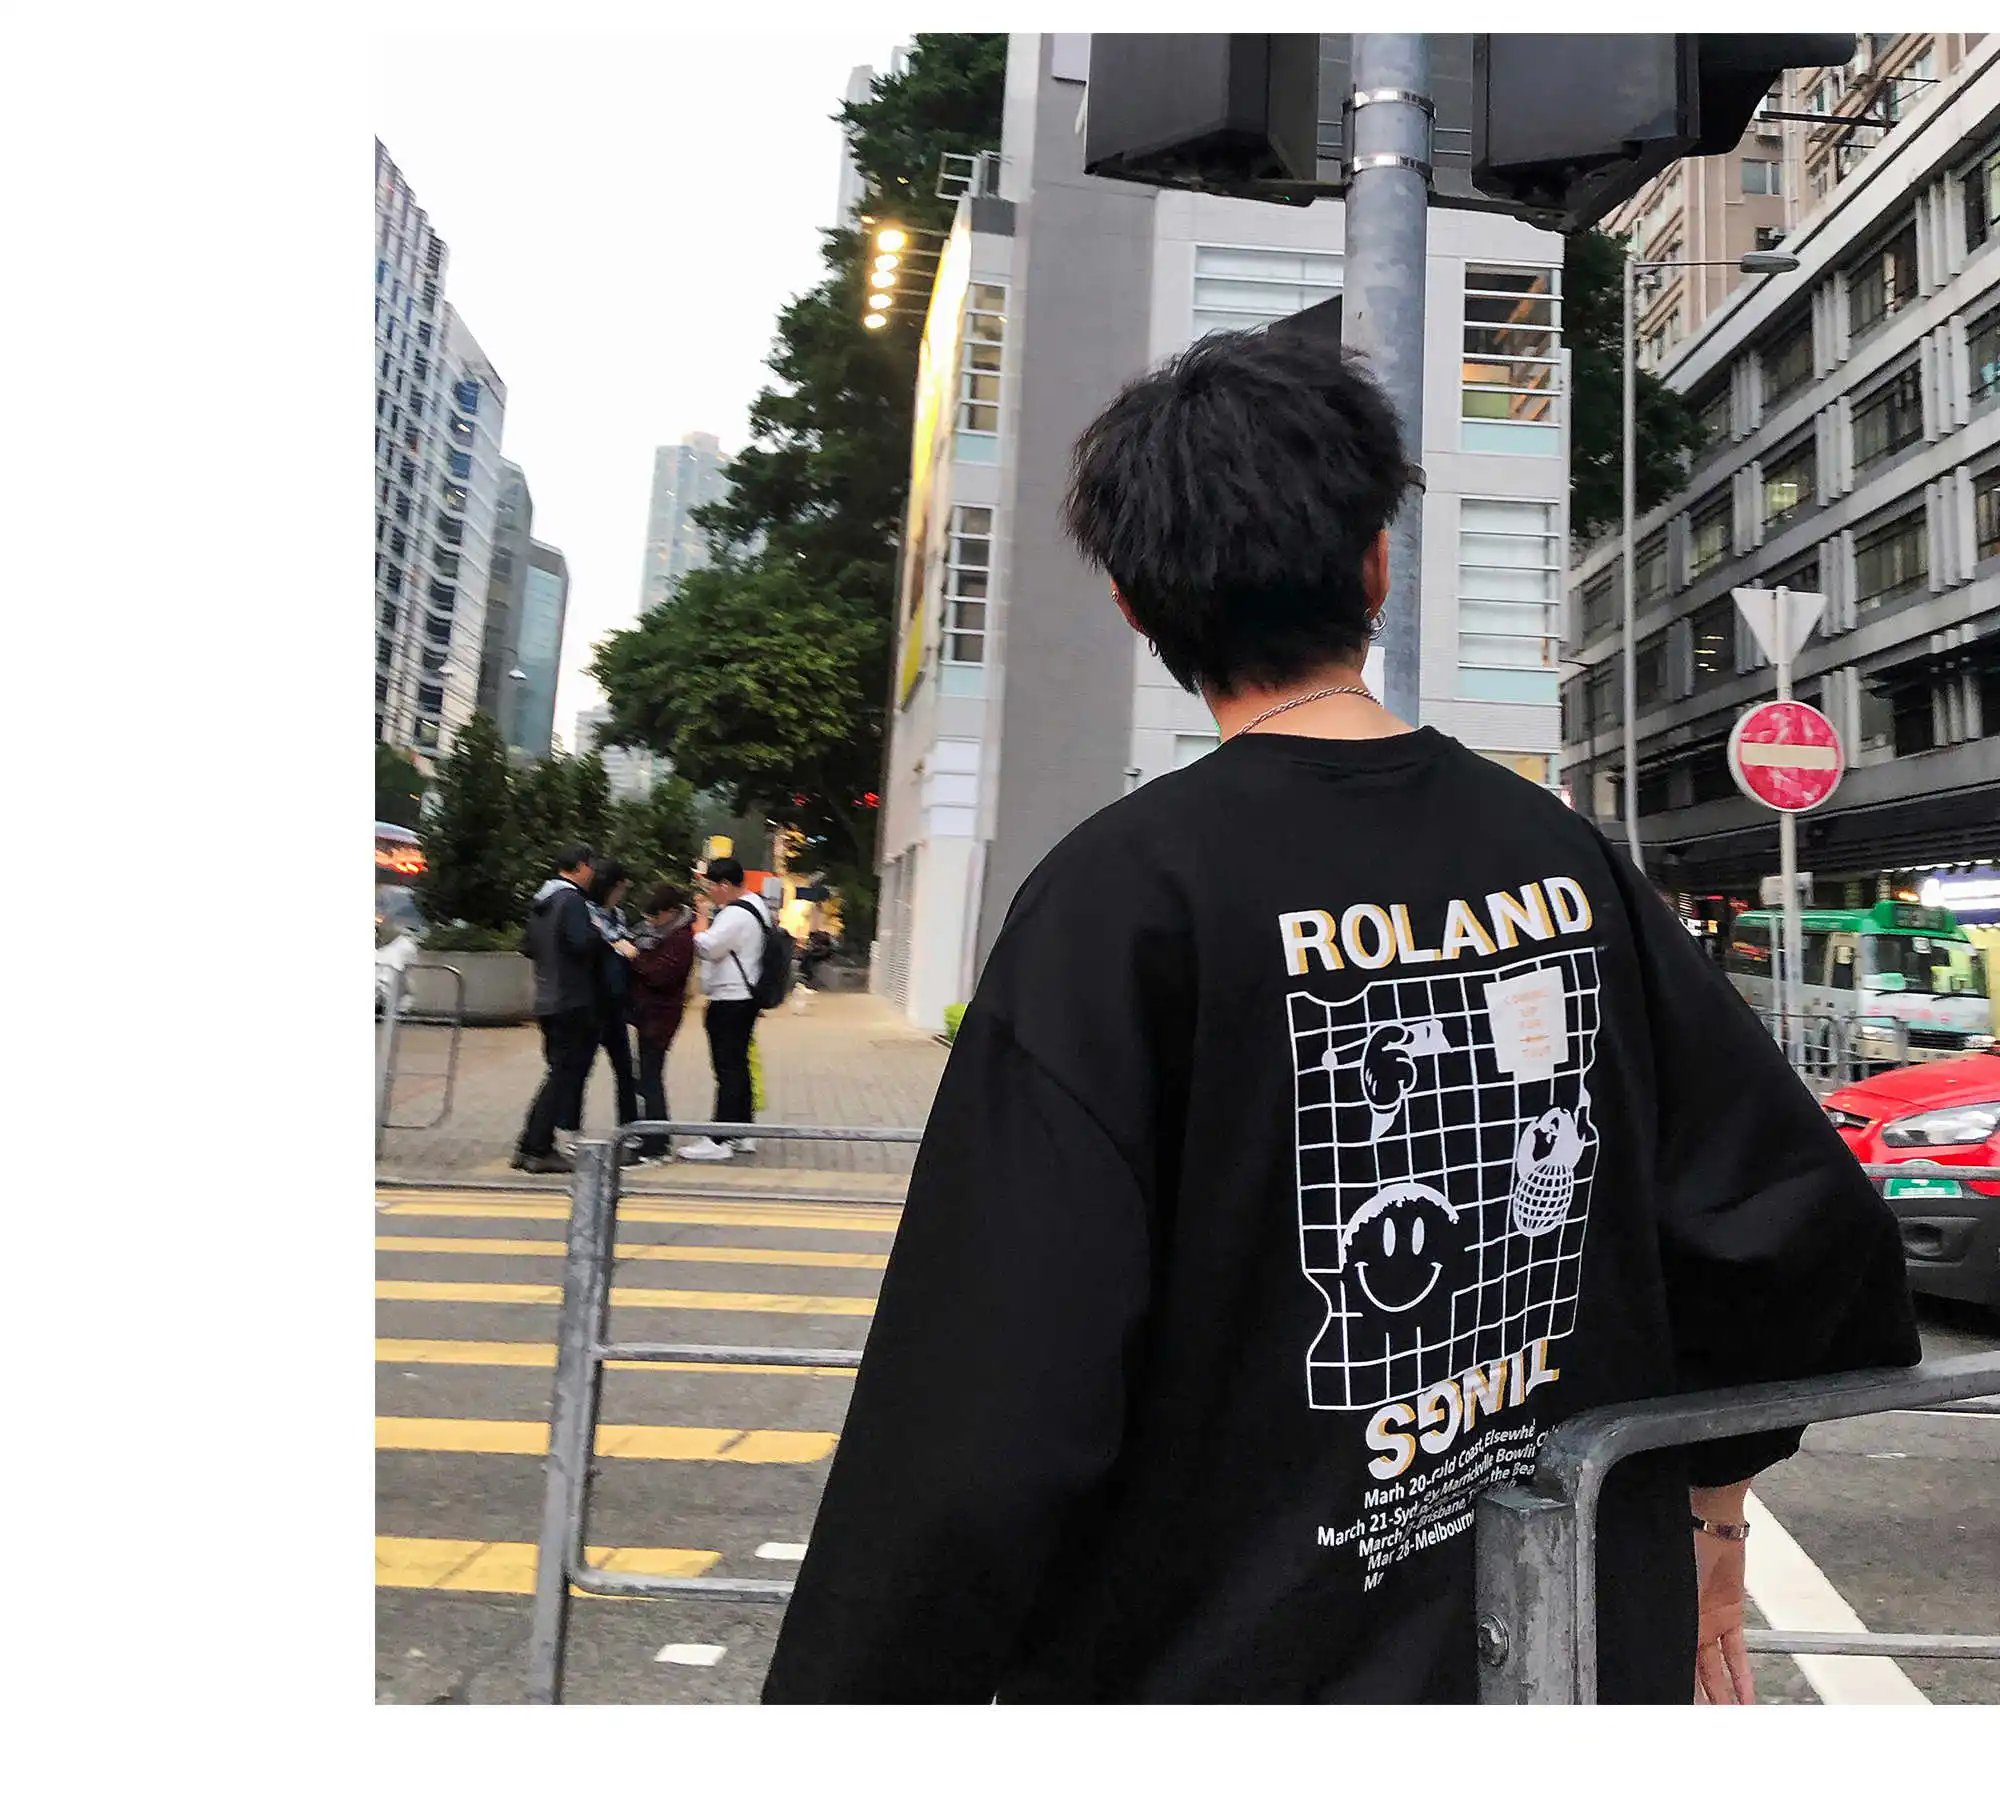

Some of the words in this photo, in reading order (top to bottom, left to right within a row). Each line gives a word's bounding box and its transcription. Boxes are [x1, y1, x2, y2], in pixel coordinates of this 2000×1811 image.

[1278, 876, 1593, 976] ROLAND
[1490, 1465, 1511, 1482] the
[1364, 1481, 1405, 1509] Marh
[1316, 1518, 1366, 1547] March
[1358, 1527, 1403, 1558] March
[1395, 1508, 1476, 1562] 28-Melbourn
